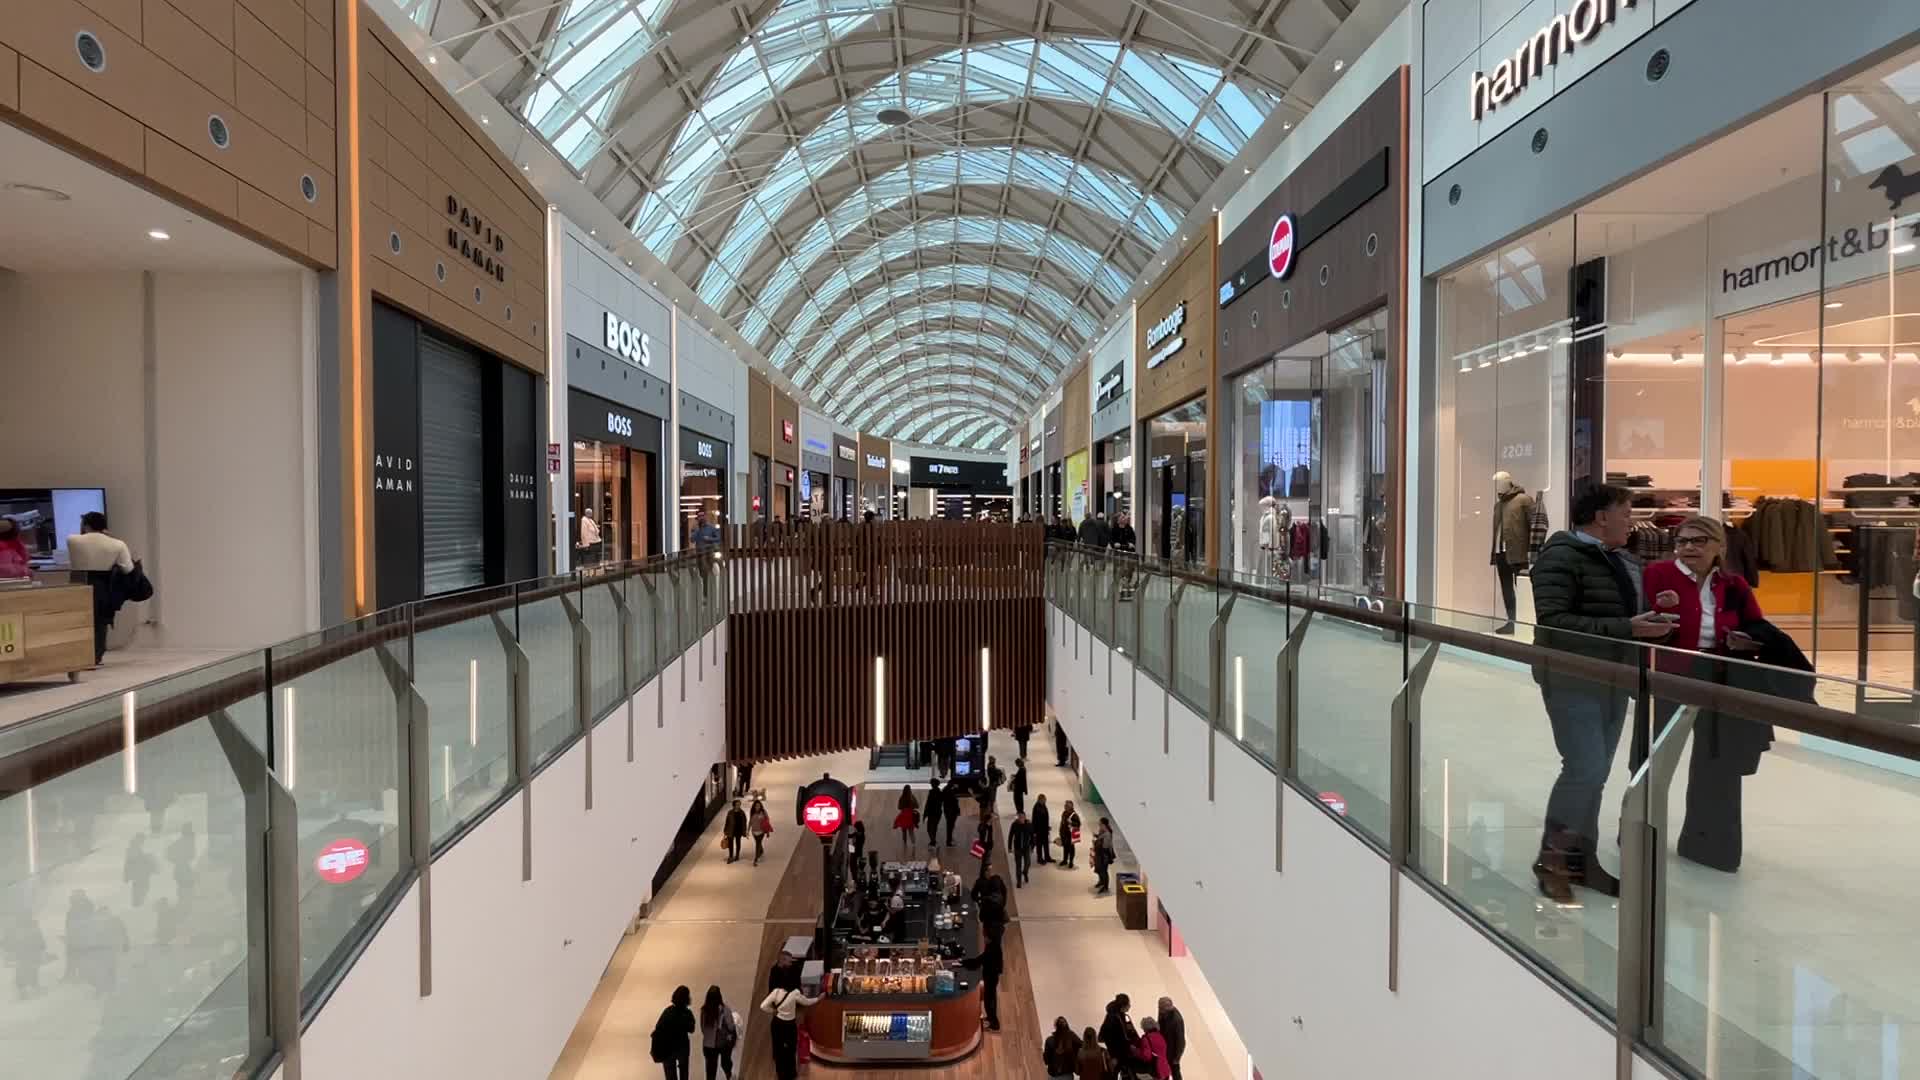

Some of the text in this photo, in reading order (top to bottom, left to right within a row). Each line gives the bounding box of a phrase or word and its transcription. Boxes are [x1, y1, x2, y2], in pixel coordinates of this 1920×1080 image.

[447, 194, 504, 252] DAVID
[604, 311, 651, 368] BOSS
[607, 411, 633, 437] BOSS
[698, 441, 713, 458] BOSS
